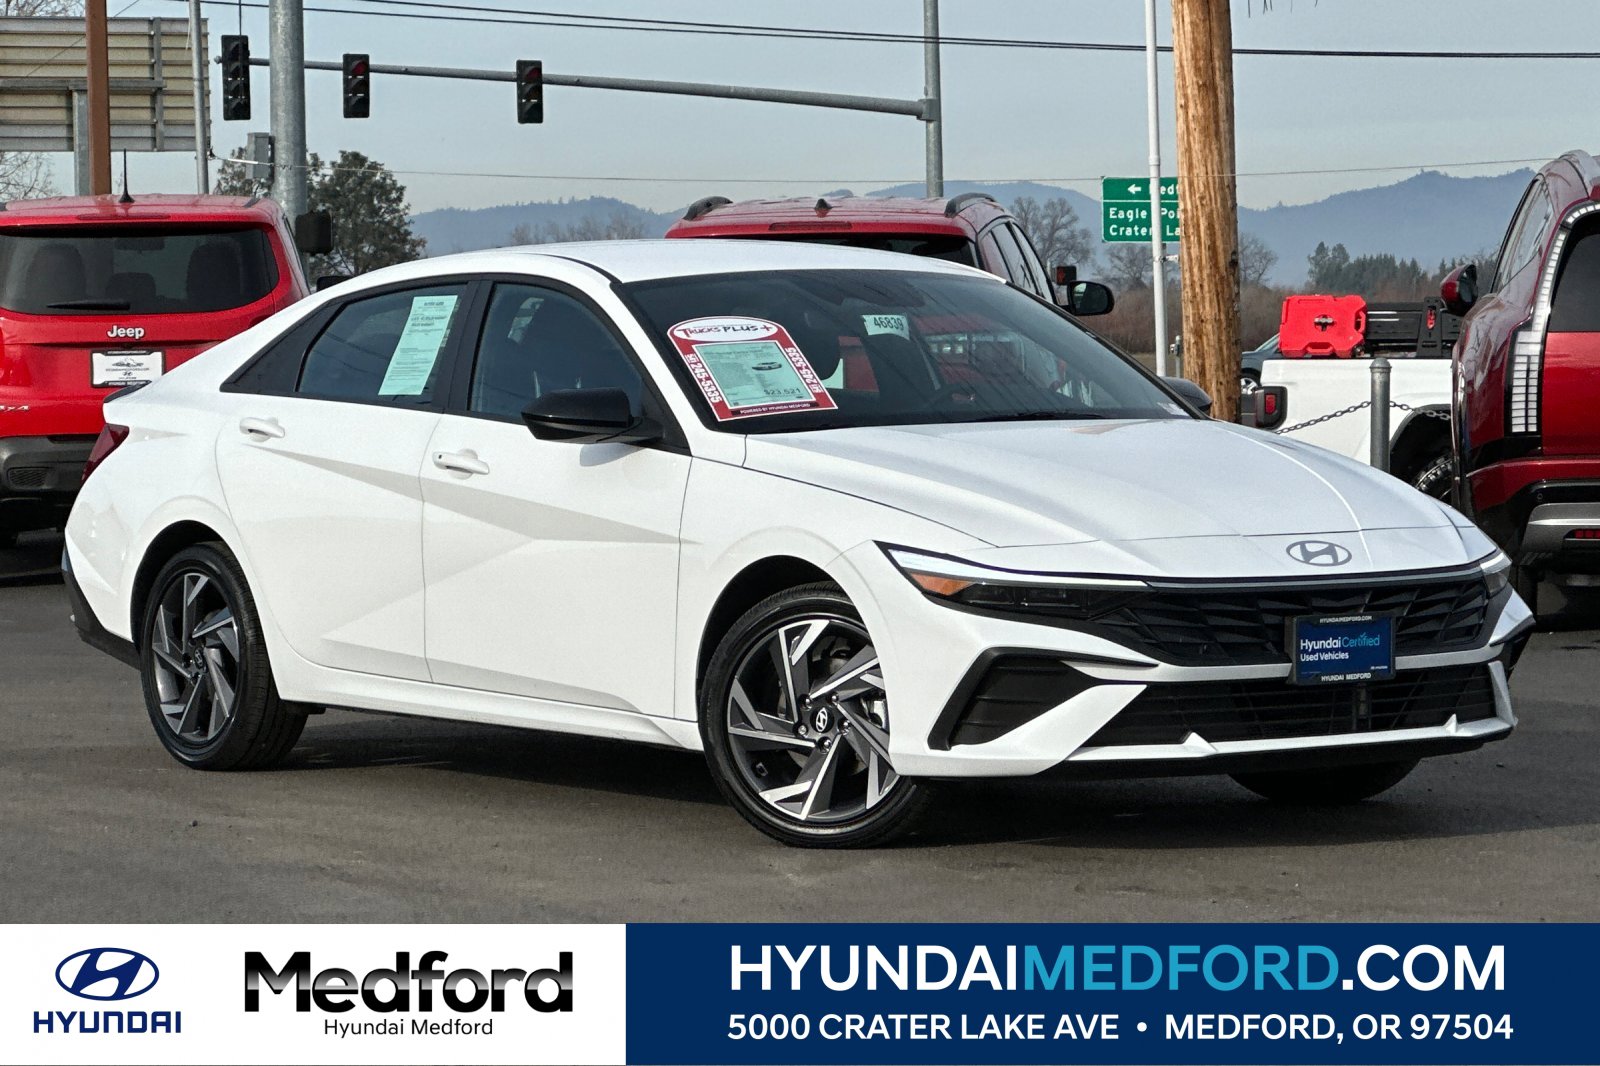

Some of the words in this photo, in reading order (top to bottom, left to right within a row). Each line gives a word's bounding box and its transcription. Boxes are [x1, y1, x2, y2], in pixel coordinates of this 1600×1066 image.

[1109, 207, 1148, 222] Eagle
[676, 326, 721, 337] TRUCKS
[873, 317, 904, 331] 46839
[107, 325, 145, 340] Jeep
[785, 347, 818, 384] 245-5335
[690, 362, 722, 403] 245-5335
[1300, 637, 1341, 652] Hyundai
[1342, 633, 1380, 648] Certified
[1300, 653, 1319, 662] Used
[1319, 652, 1349, 661] Vehicles
[1345, 672, 1372, 680] MEDFORD
